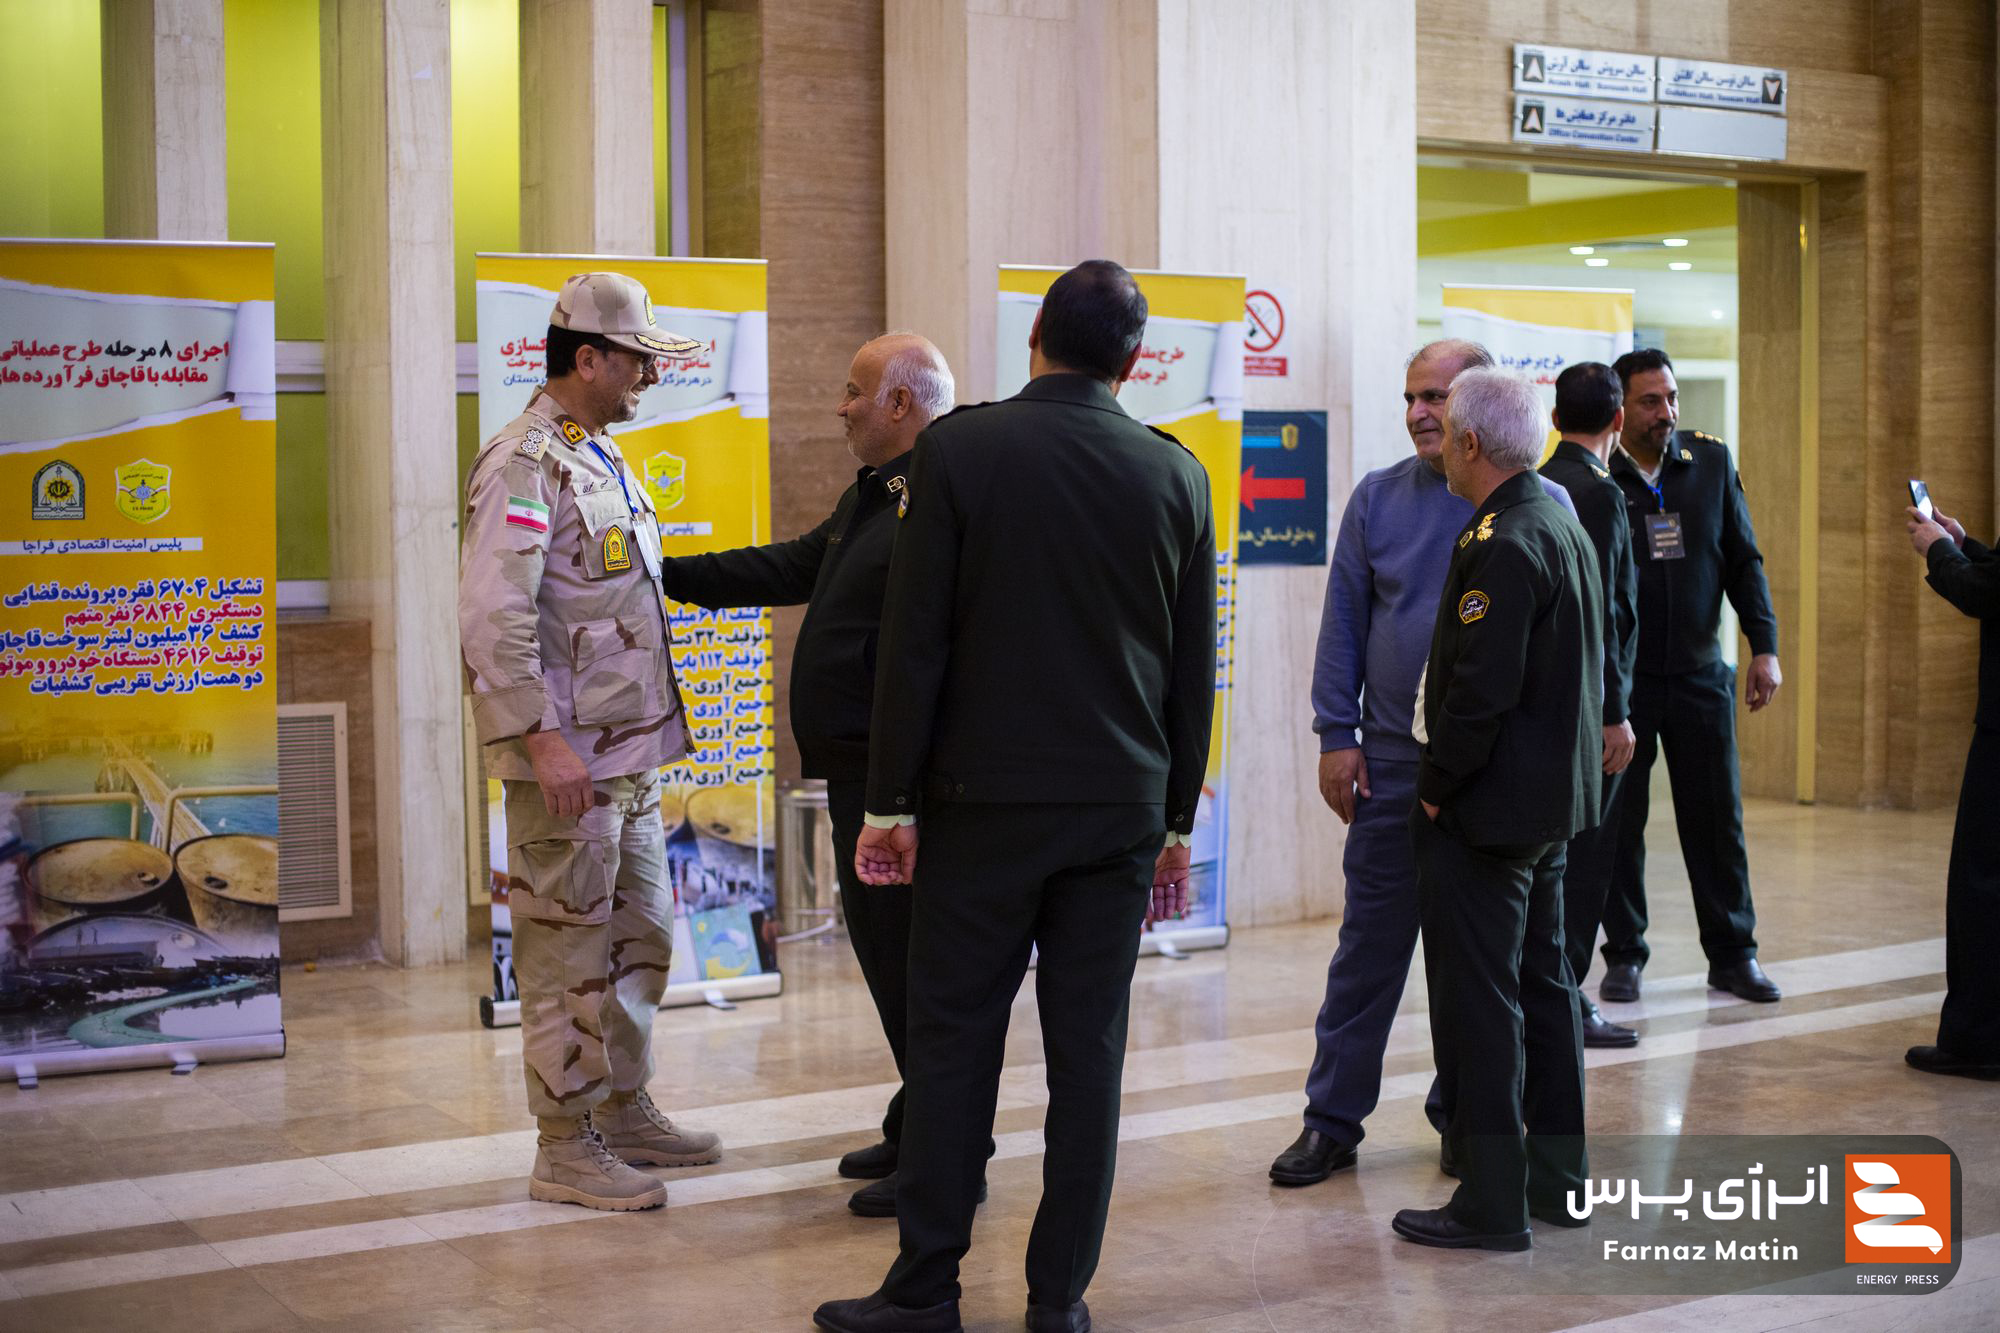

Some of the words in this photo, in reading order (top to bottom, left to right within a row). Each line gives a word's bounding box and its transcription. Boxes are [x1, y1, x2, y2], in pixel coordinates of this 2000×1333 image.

[0, 339, 61, 362] عملیاتی
[62, 339, 102, 362] طرح
[104, 339, 157, 362] مرحله
[159, 339, 173, 359] ۸
[176, 340, 229, 362] اجرای
[1157, 346, 1185, 365] طرح
[507, 356, 543, 371] سوخت
[95, 365, 145, 389] قاچاق
[147, 365, 160, 388] با
[161, 365, 208, 387] مقابله
[667, 524, 695, 536] پلیس
[23, 538, 55, 554] فراجا
[57, 538, 110, 554] اقتصادی
[113, 538, 147, 551] امنیت
[150, 538, 182, 553] پلیس
[4, 582, 60, 607] قضایی
[61, 584, 117, 605] پرونده
[117, 580, 155, 603] فقره
[158, 579, 207, 598] ۶۷۰۴
[210, 579, 263, 600] تشکیل
[65, 607, 103, 628] متهم
[107, 606, 130, 627] نفر
[132, 602, 186, 622] ۶۸۴۴
[189, 603, 262, 624] دستگیری
[43, 632, 99, 651] سوخت
[101, 626, 132, 650] لیتر
[134, 626, 187, 649] میلیون
[188, 623, 214, 643] ۳۶
[219, 623, 262, 641] کشف
[726, 627, 763, 646] توقیف
[47, 652, 102, 674] خودرو
[103, 649, 161, 667] دستگاه
[164, 646, 211, 666] ۴۶۱۶
[214, 645, 263, 666] توقیف
[726, 650, 763, 670] توقیف
[30, 675, 94, 696] کشفیات
[96, 672, 152, 695] تقریبی
[153, 670, 200, 692] ارزش
[201, 672, 243, 687] همت
[244, 671, 263, 690] دو
[695, 673, 732, 694] آوری
[734, 678, 762, 693] جمع
[694, 696, 732, 718] آوری
[734, 701, 763, 716] جمع
[695, 719, 732, 740] آوری
[735, 723, 763, 738] جمع
[696, 742, 732, 762] آوری
[735, 745, 764, 761] جمع
[696, 764, 733, 785] آوری
[736, 768, 764, 783] جمع
